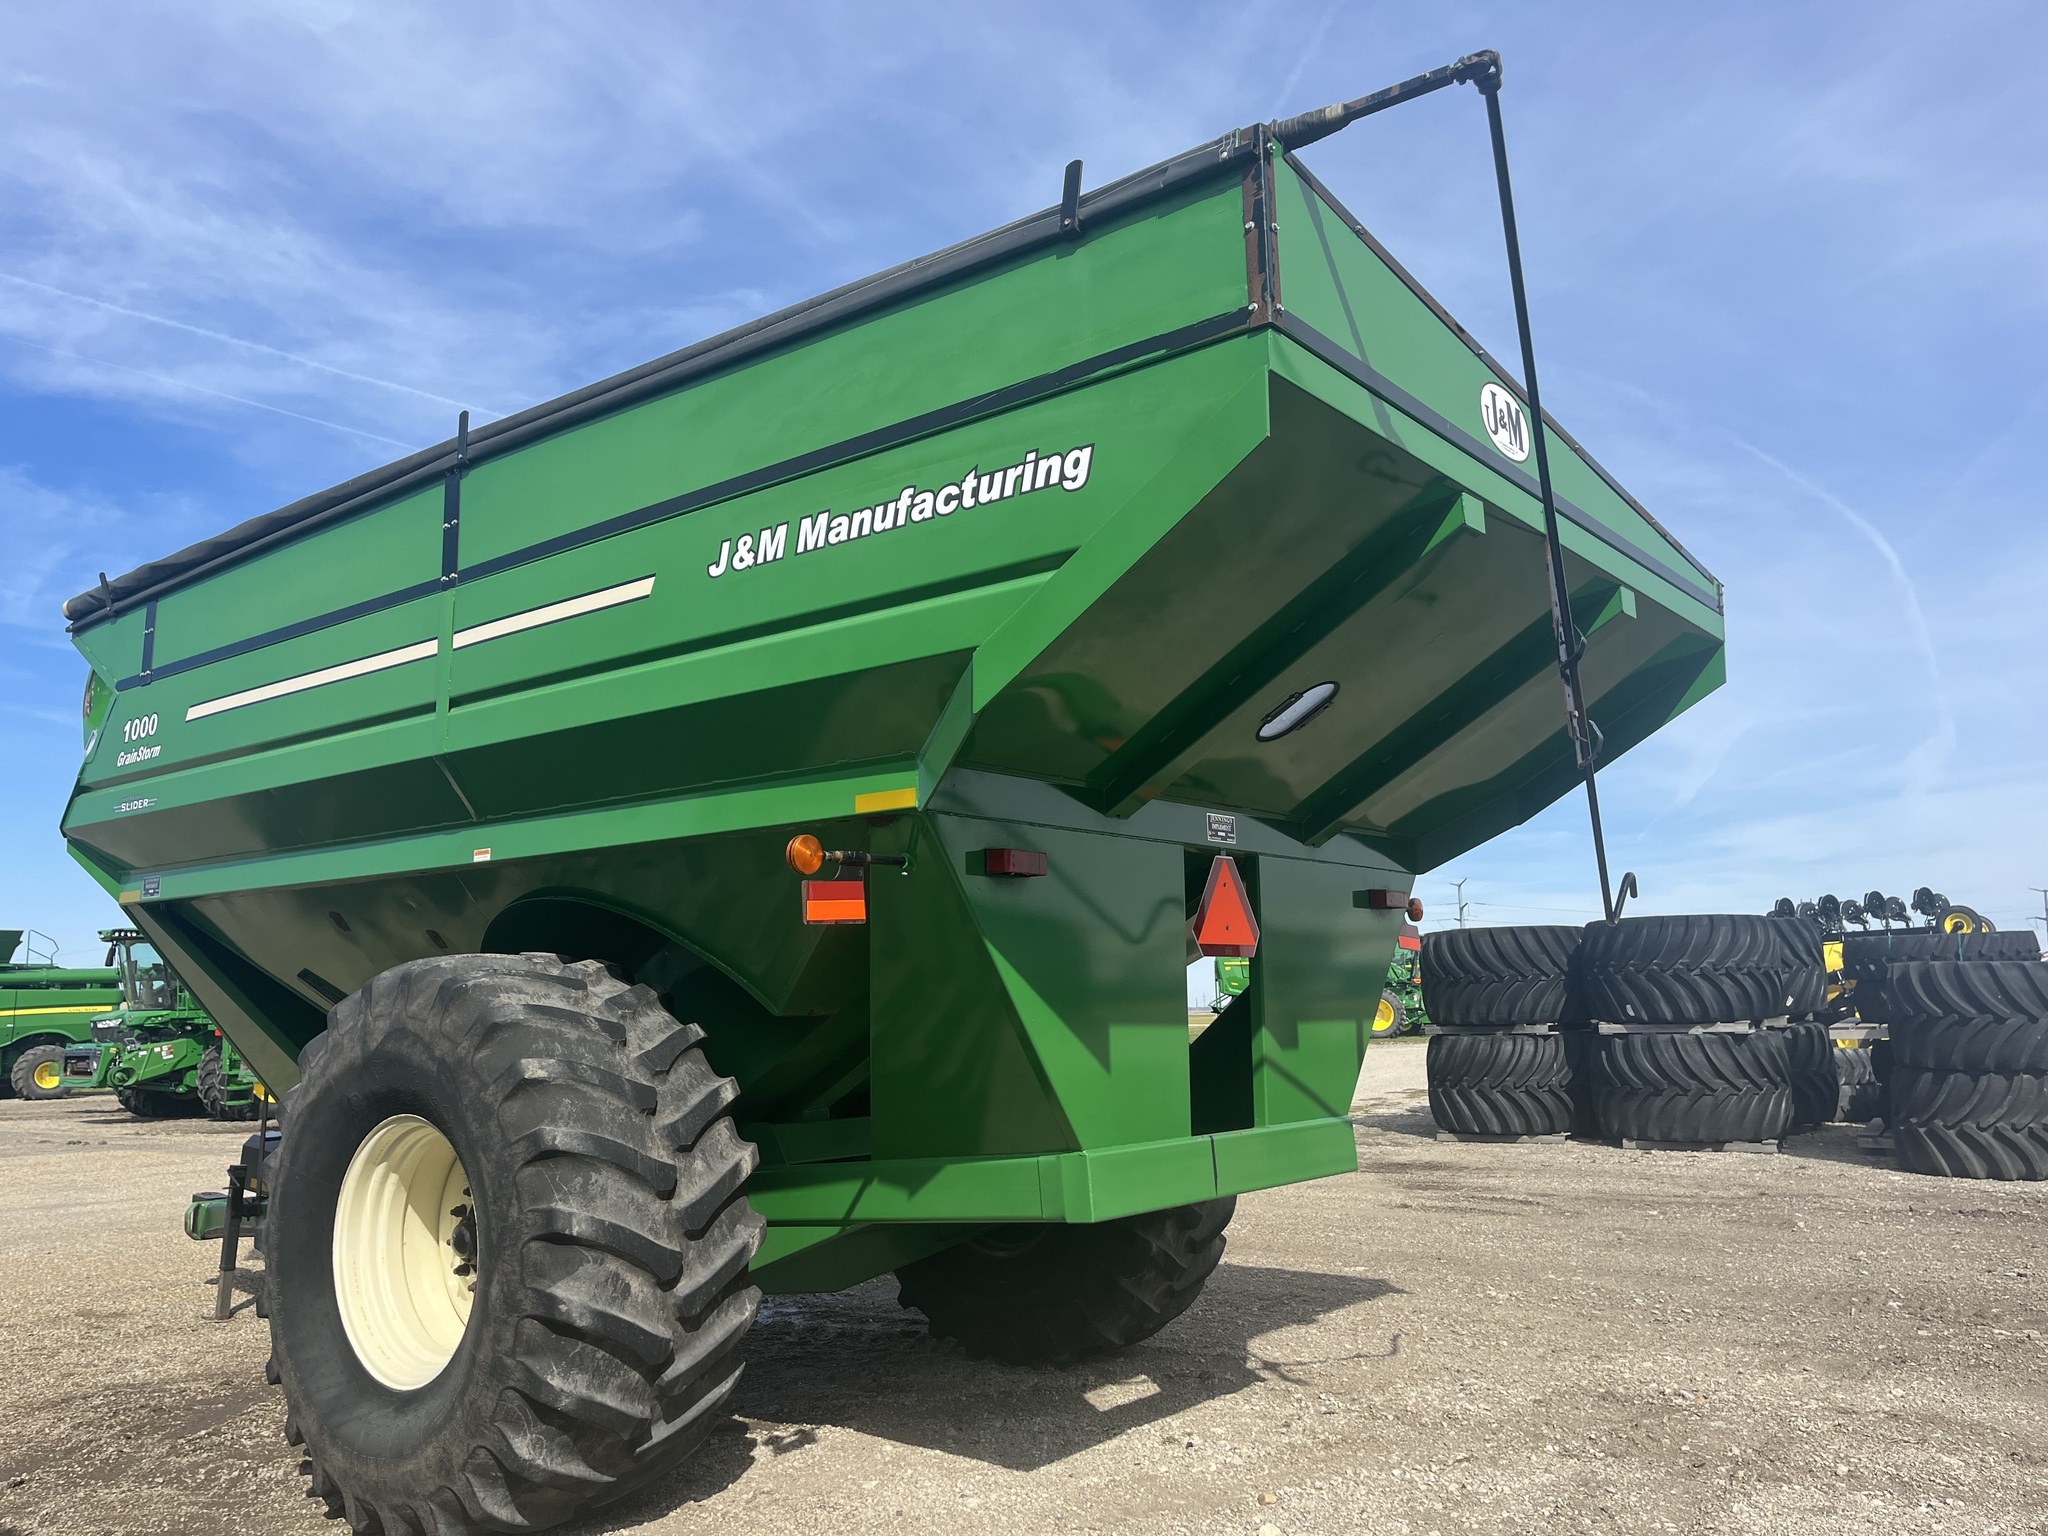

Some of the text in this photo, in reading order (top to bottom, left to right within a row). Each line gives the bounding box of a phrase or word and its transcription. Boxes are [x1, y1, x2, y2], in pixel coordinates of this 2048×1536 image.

[1484, 389, 1525, 454] J&M
[707, 442, 1096, 578] J&M Manufacturing
[123, 712, 158, 743] 1000
[120, 799, 149, 812] SLIDER
